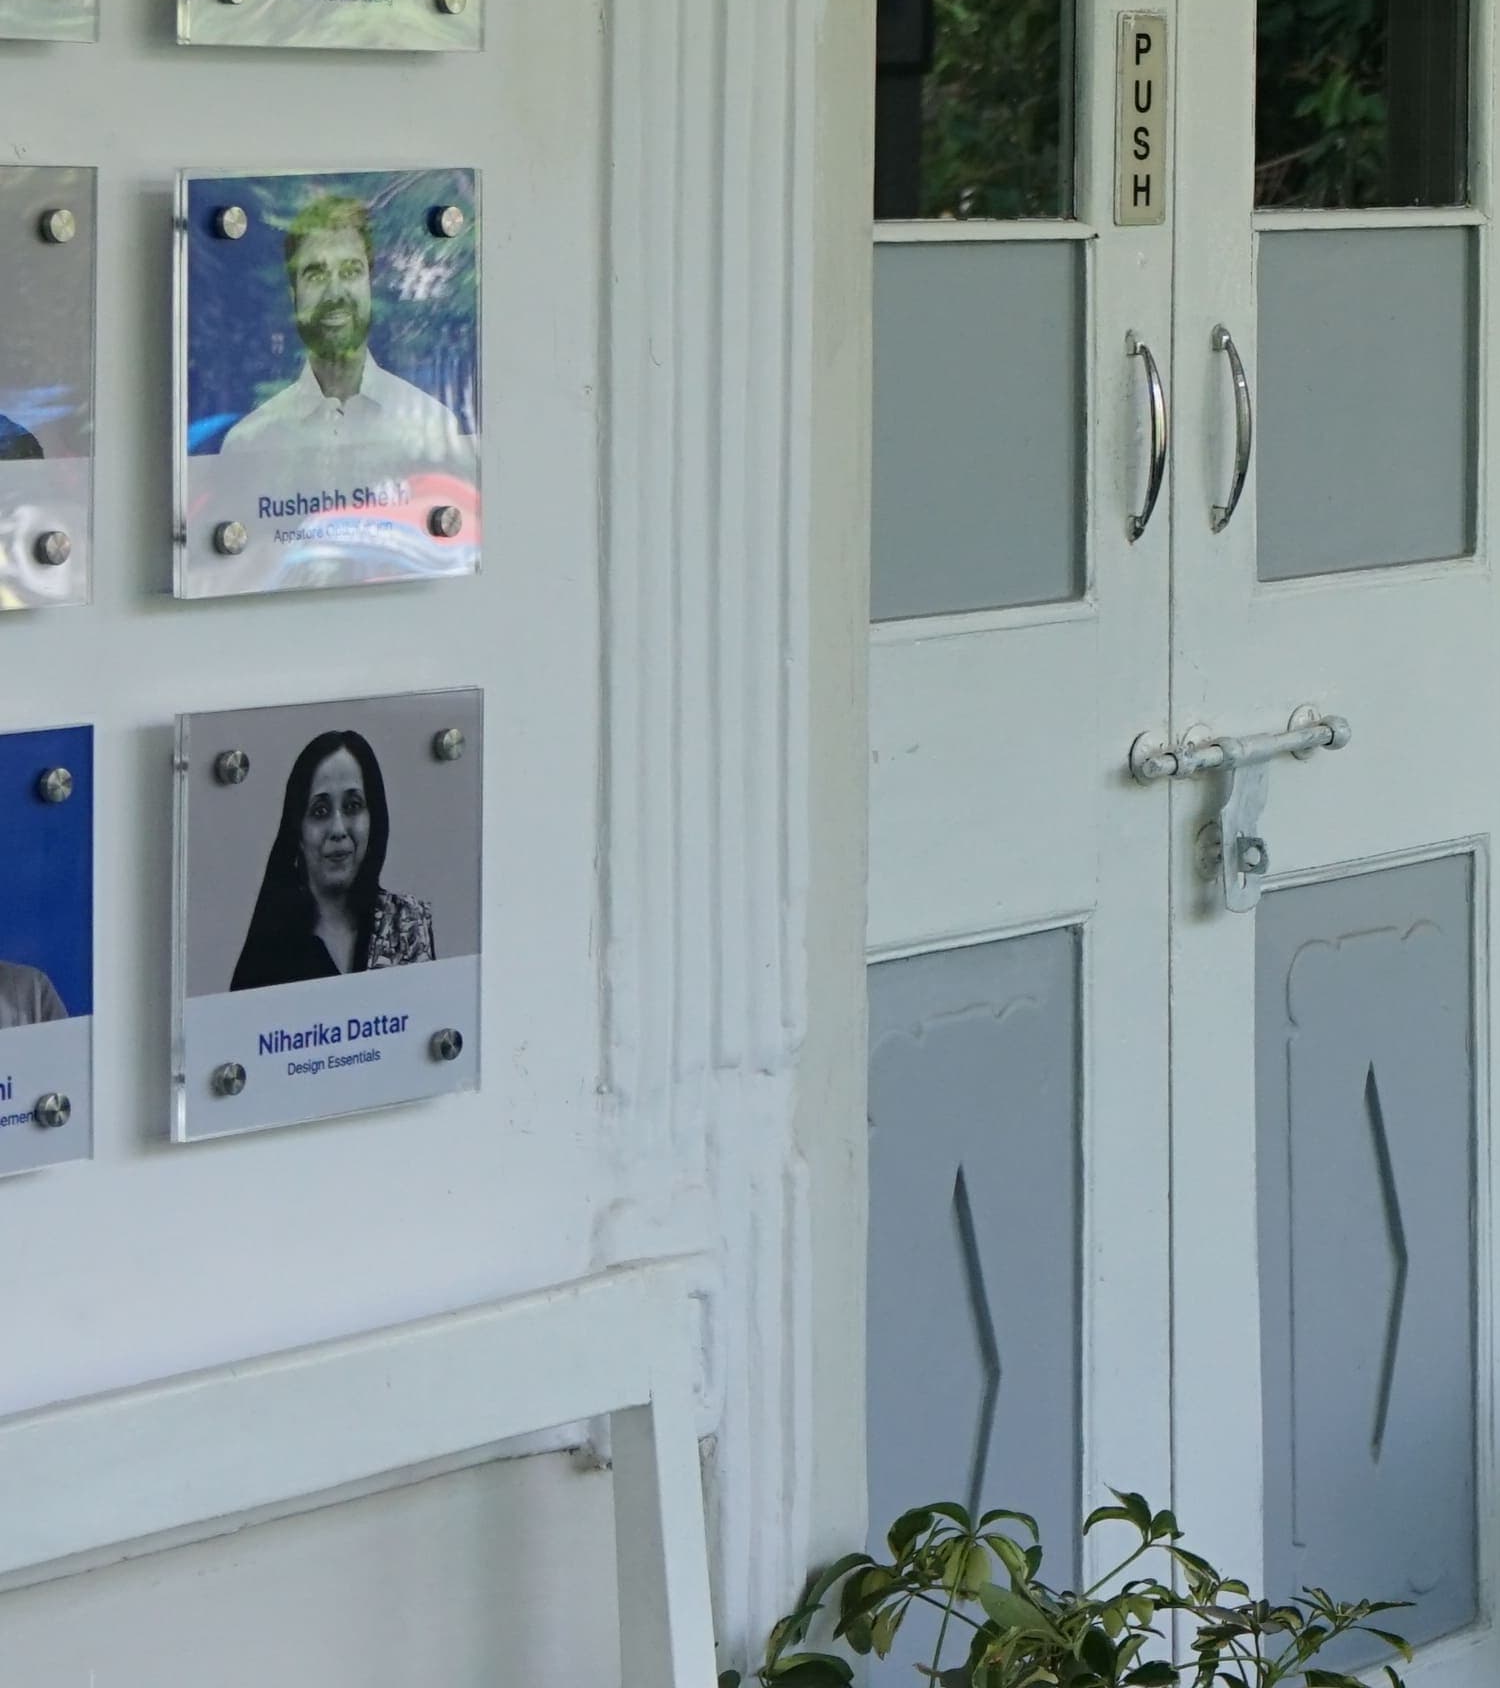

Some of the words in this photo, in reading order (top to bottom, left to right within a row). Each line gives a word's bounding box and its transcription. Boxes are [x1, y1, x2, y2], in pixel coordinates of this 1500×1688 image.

[1133, 33, 1152, 207] PUSH
[258, 488, 347, 518] Rushabh
[258, 1023, 342, 1056] Niharika
[347, 1015, 409, 1041] Dattar
[287, 1059, 325, 1076] Design
[327, 1048, 381, 1070] Essentials
